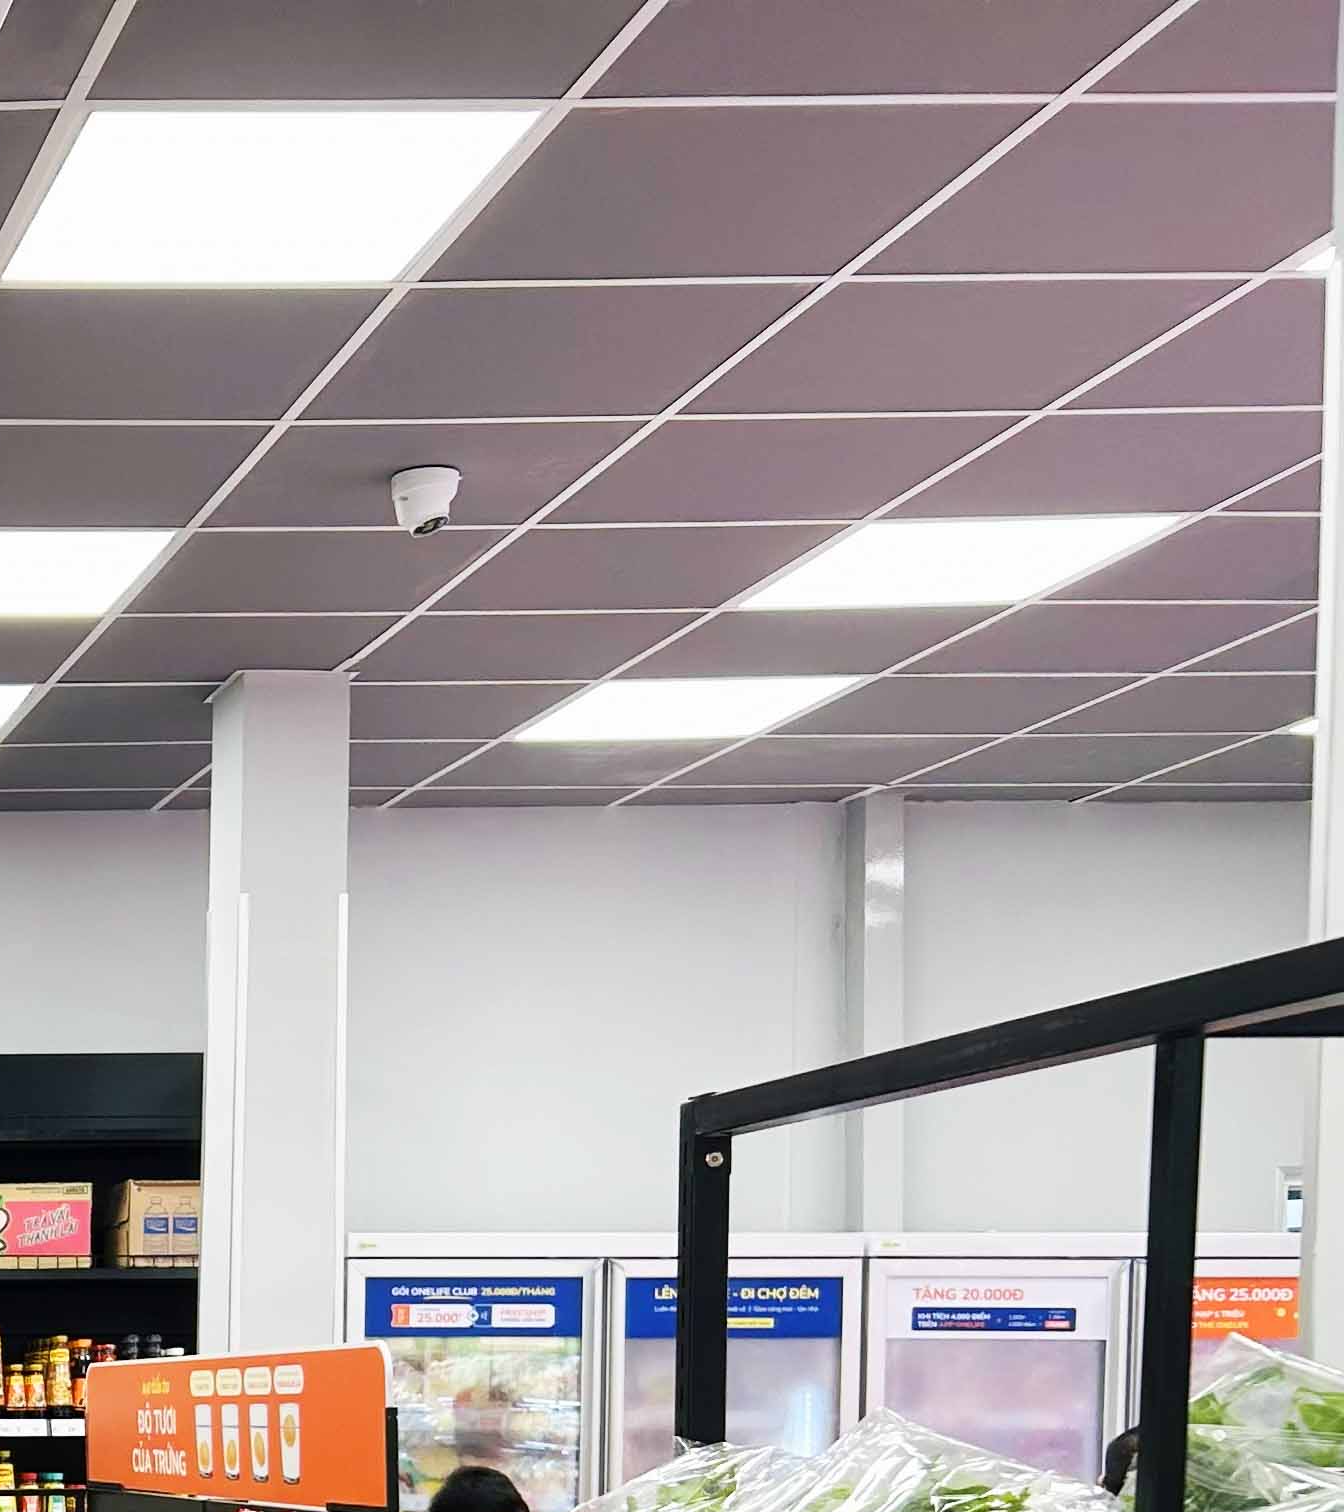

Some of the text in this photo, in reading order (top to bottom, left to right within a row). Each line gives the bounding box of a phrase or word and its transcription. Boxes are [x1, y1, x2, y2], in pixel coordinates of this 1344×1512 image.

[758, 1286, 788, 1303] CHỢ
[790, 1284, 820, 1300] ĐÊM
[1229, 1287, 1294, 1302] 25.000Đ
